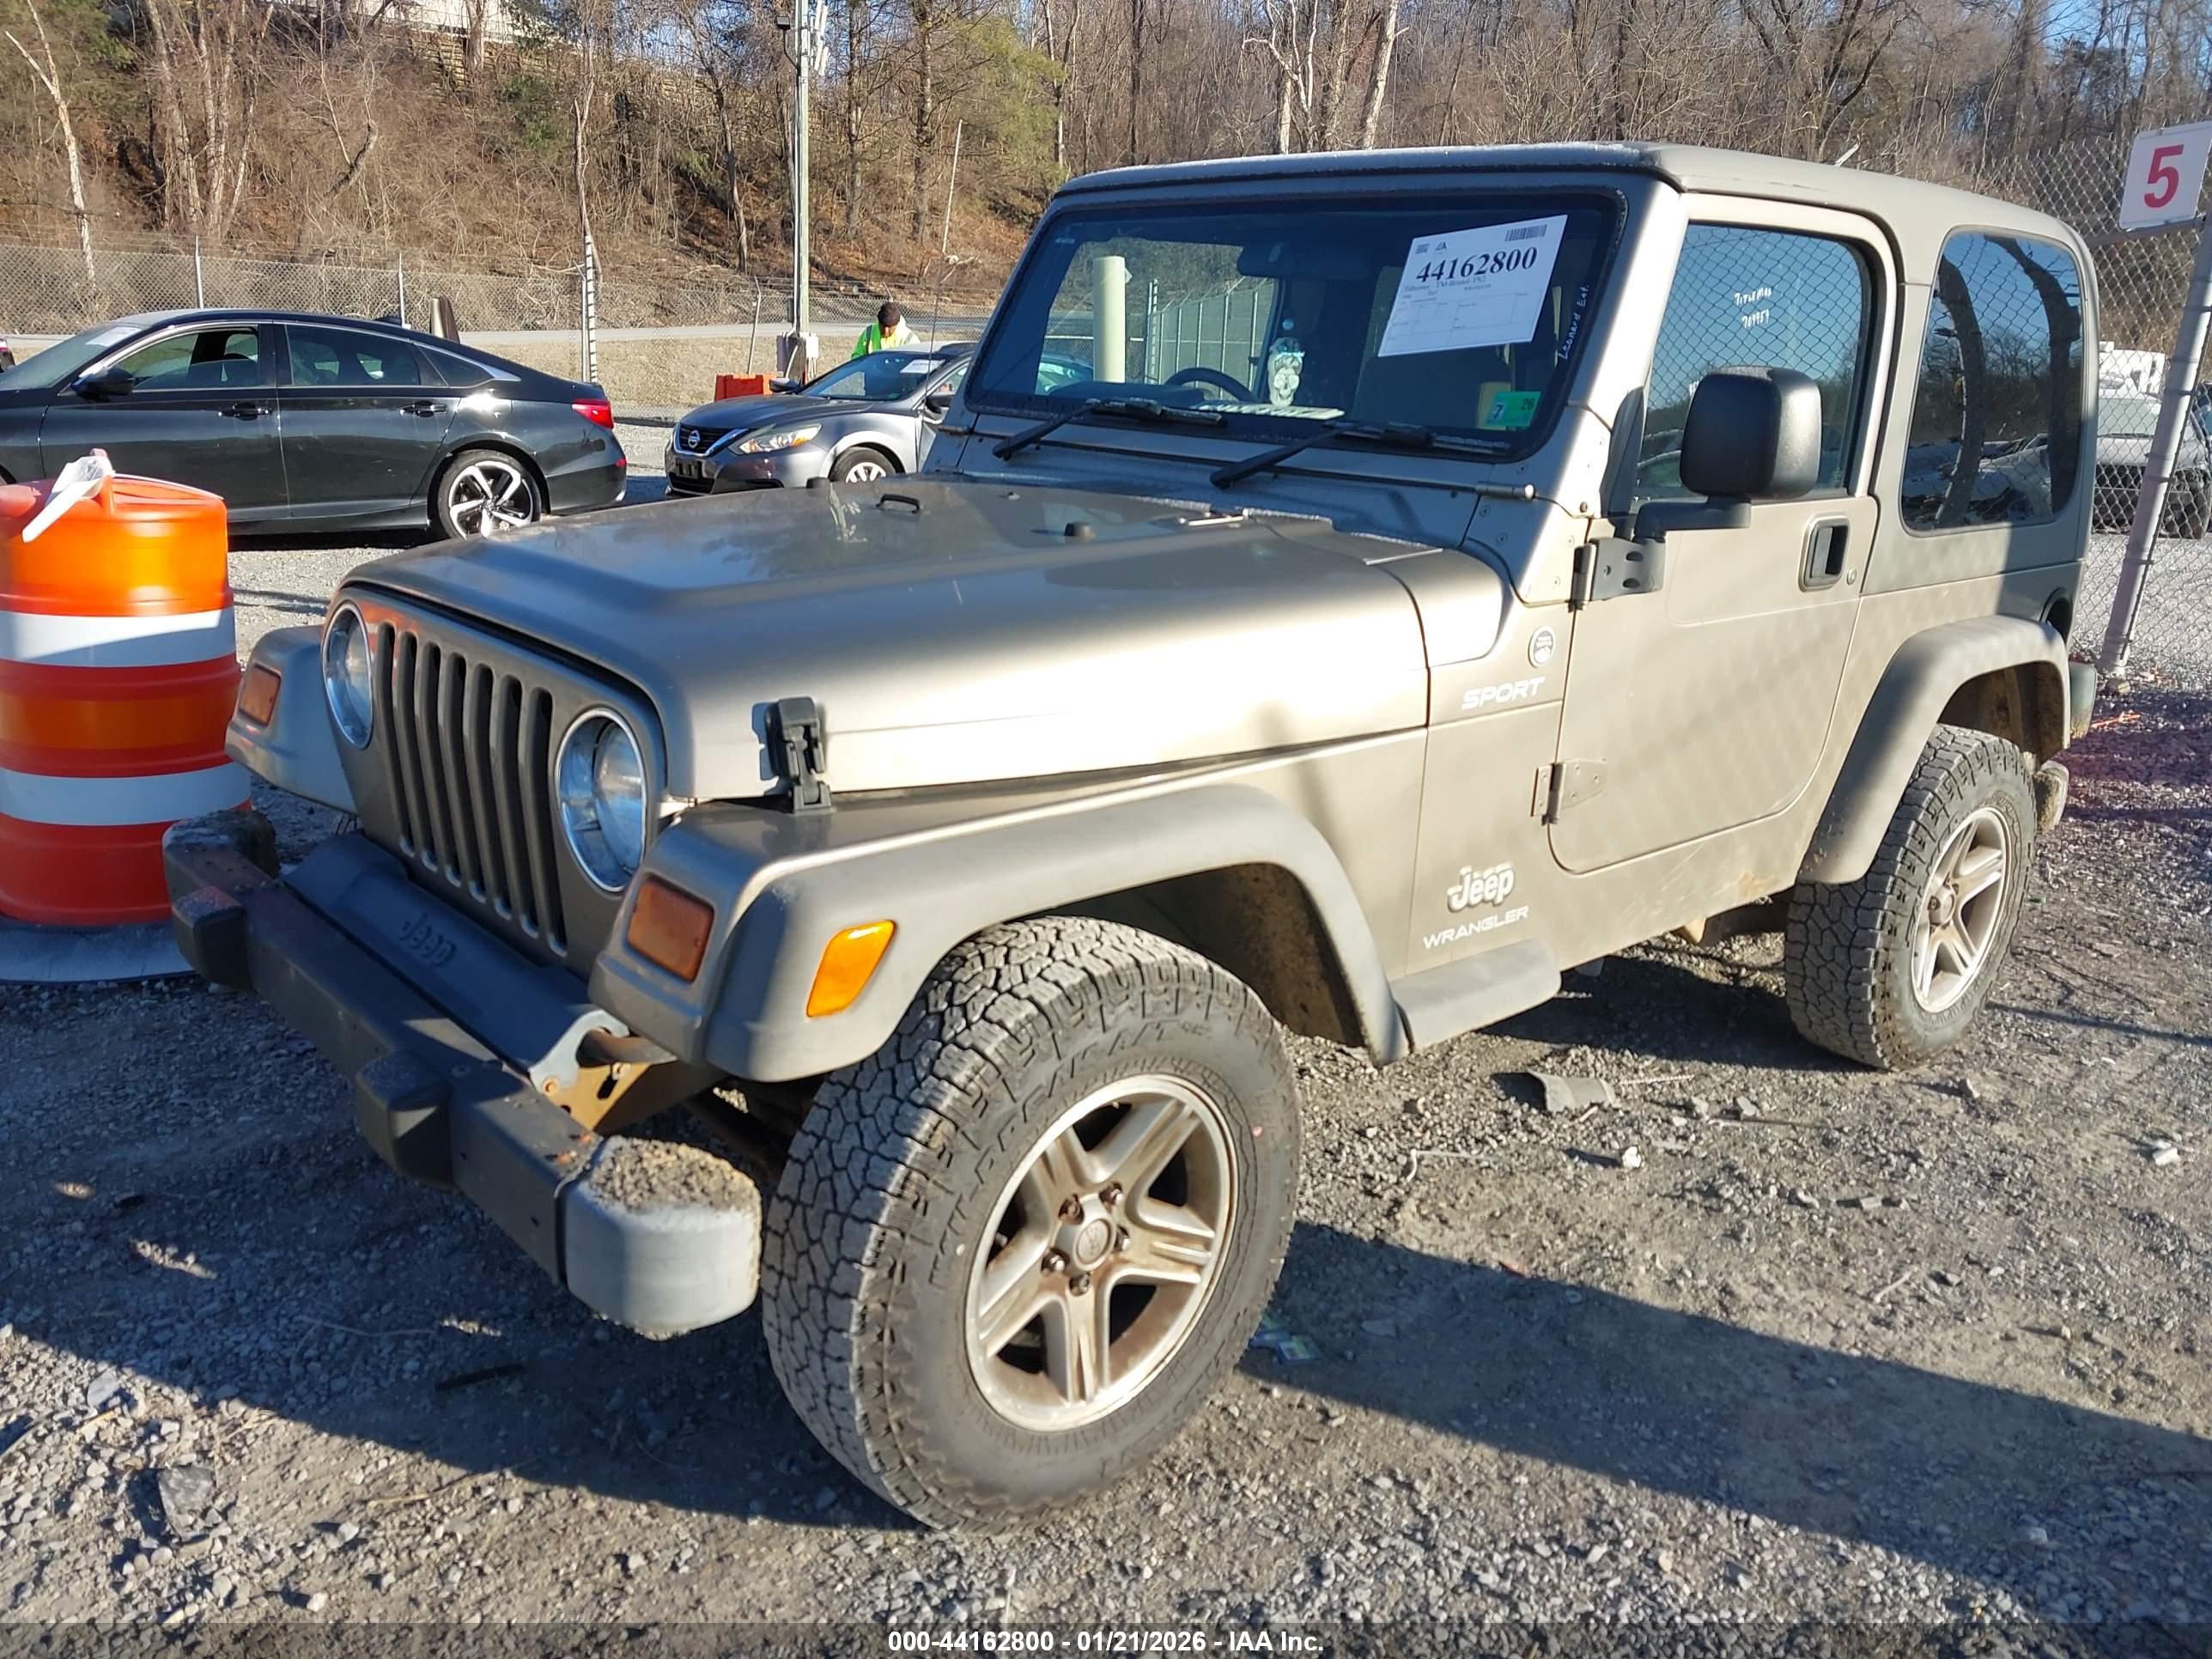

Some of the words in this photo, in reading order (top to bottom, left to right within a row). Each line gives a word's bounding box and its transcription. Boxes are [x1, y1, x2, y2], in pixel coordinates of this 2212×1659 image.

[2144, 144, 2185, 208] 5
[1416, 246, 1538, 282] 44162800
[1462, 677, 1546, 710] SPORT
[1447, 862, 1515, 913] Jeep
[398, 914, 456, 969] Jeep
[1424, 906, 1528, 949] WRANGLER
